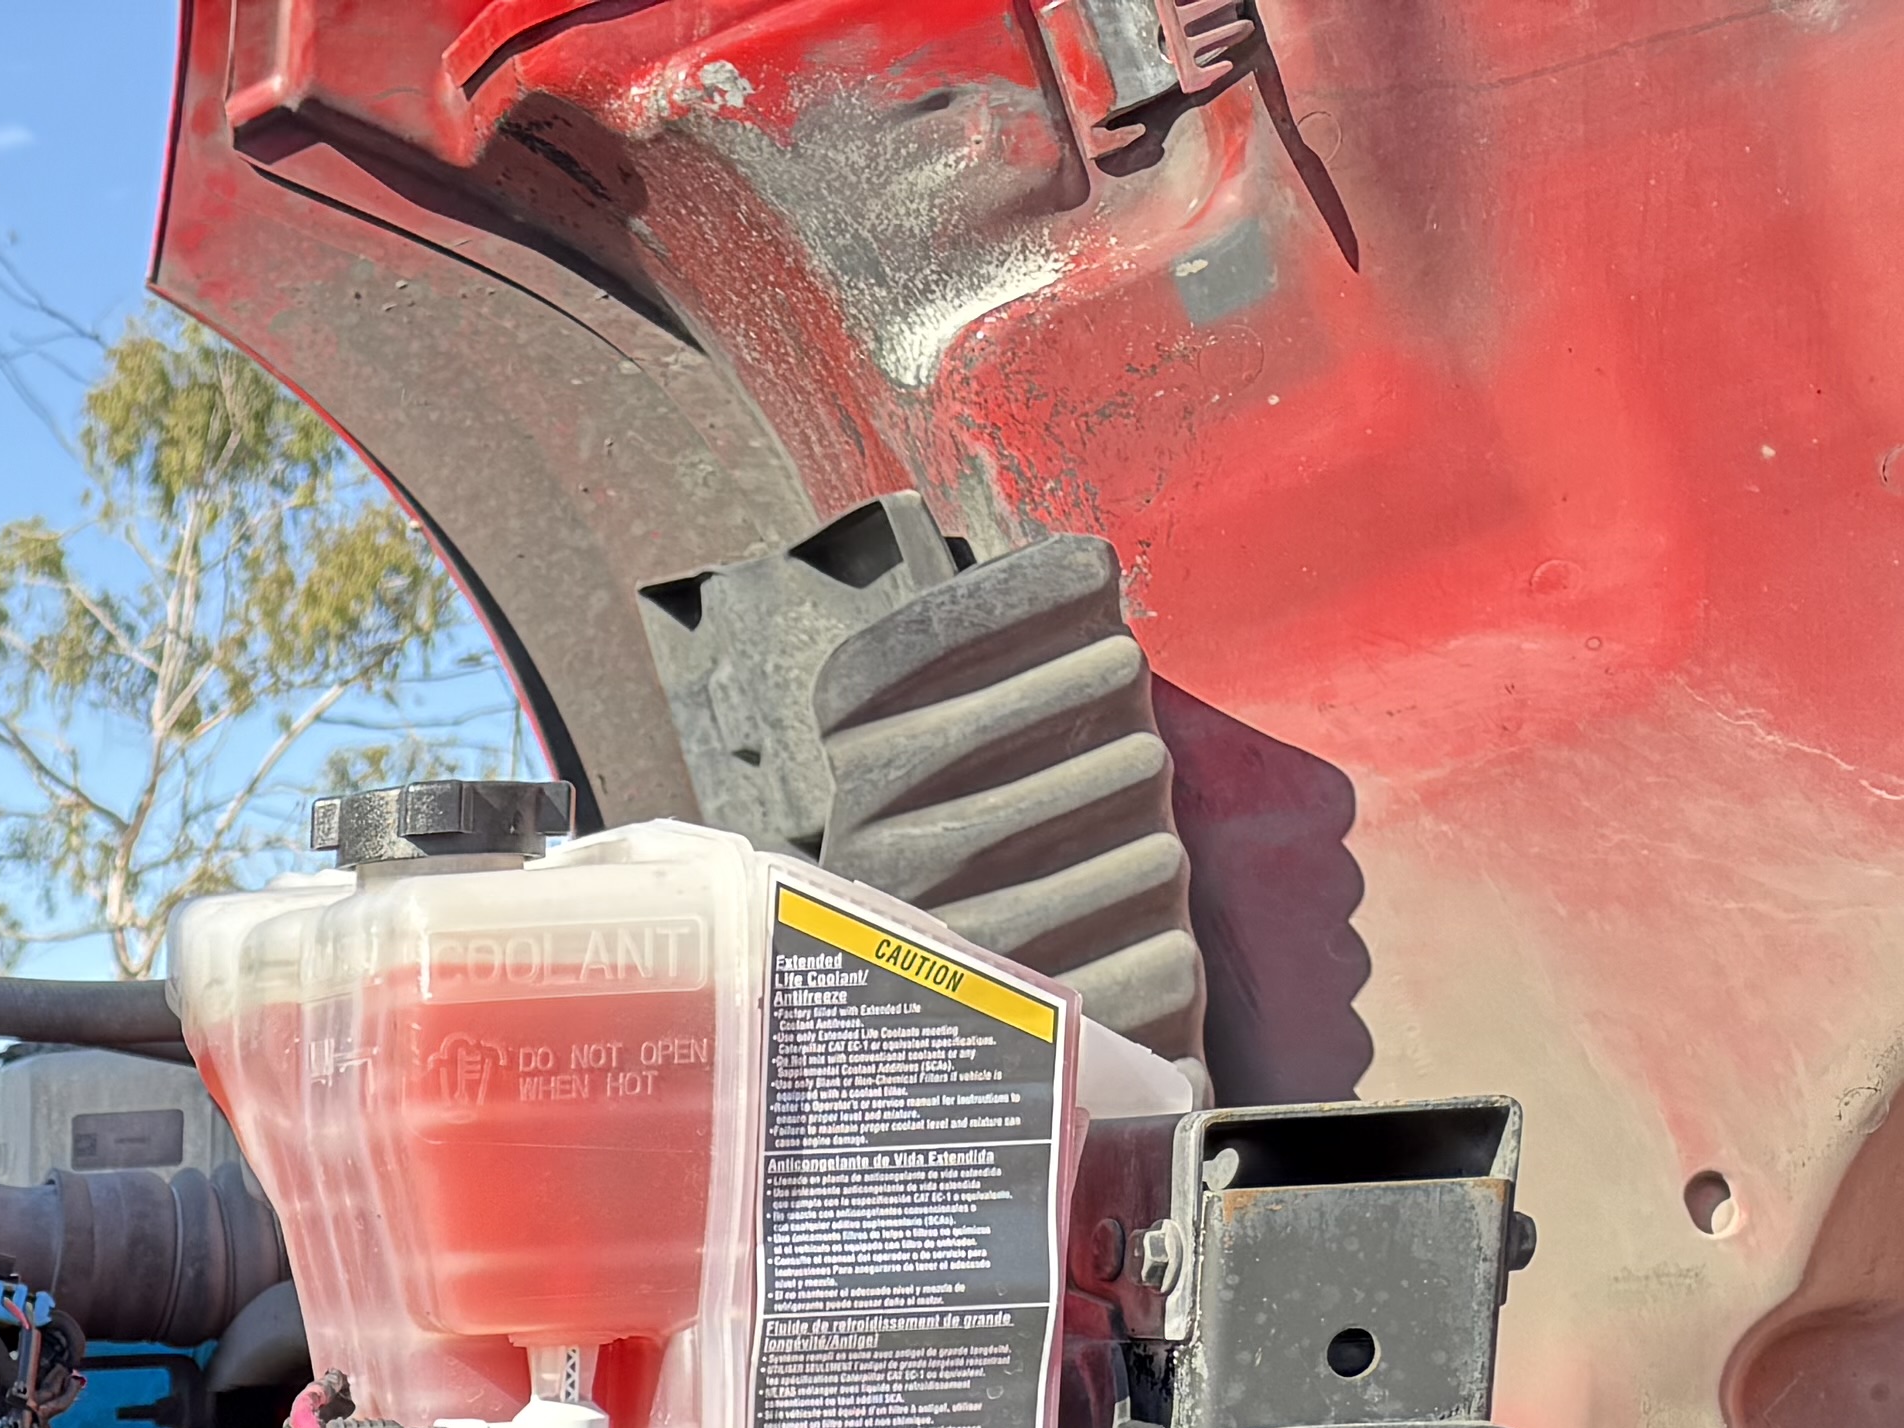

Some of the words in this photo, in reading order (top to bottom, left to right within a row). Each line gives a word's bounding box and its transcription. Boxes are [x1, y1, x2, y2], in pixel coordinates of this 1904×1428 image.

[436, 927, 690, 985] COOLANT
[776, 952, 843, 970] Extended
[874, 938, 964, 993] CAUTION
[775, 971, 803, 988] Life
[807, 969, 869, 987] Coolant/
[774, 989, 847, 1006] Antifreeze
[518, 1047, 554, 1073] DO
[570, 1042, 623, 1070] NOT
[640, 1038, 708, 1066] OPEN
[519, 1074, 589, 1102] WHEN
[607, 1071, 658, 1098] HOT
